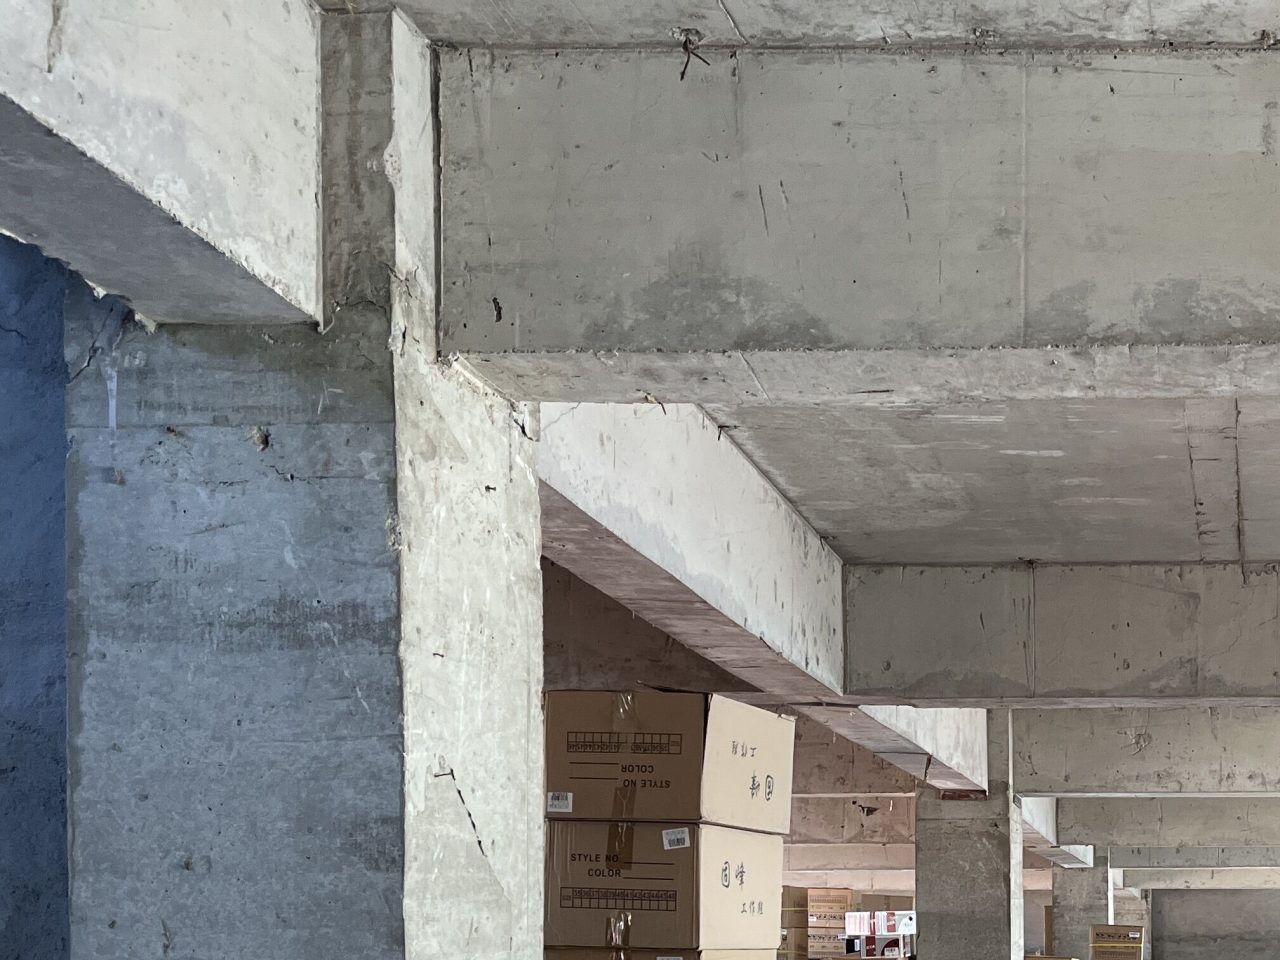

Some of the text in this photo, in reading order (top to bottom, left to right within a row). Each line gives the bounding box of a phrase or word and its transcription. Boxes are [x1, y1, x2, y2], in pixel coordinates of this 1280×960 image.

[620, 764, 654, 774] COLOR
[641, 780, 670, 788] STYLE
[570, 853, 601, 863] STYLE
[588, 868, 622, 878] COLOR
